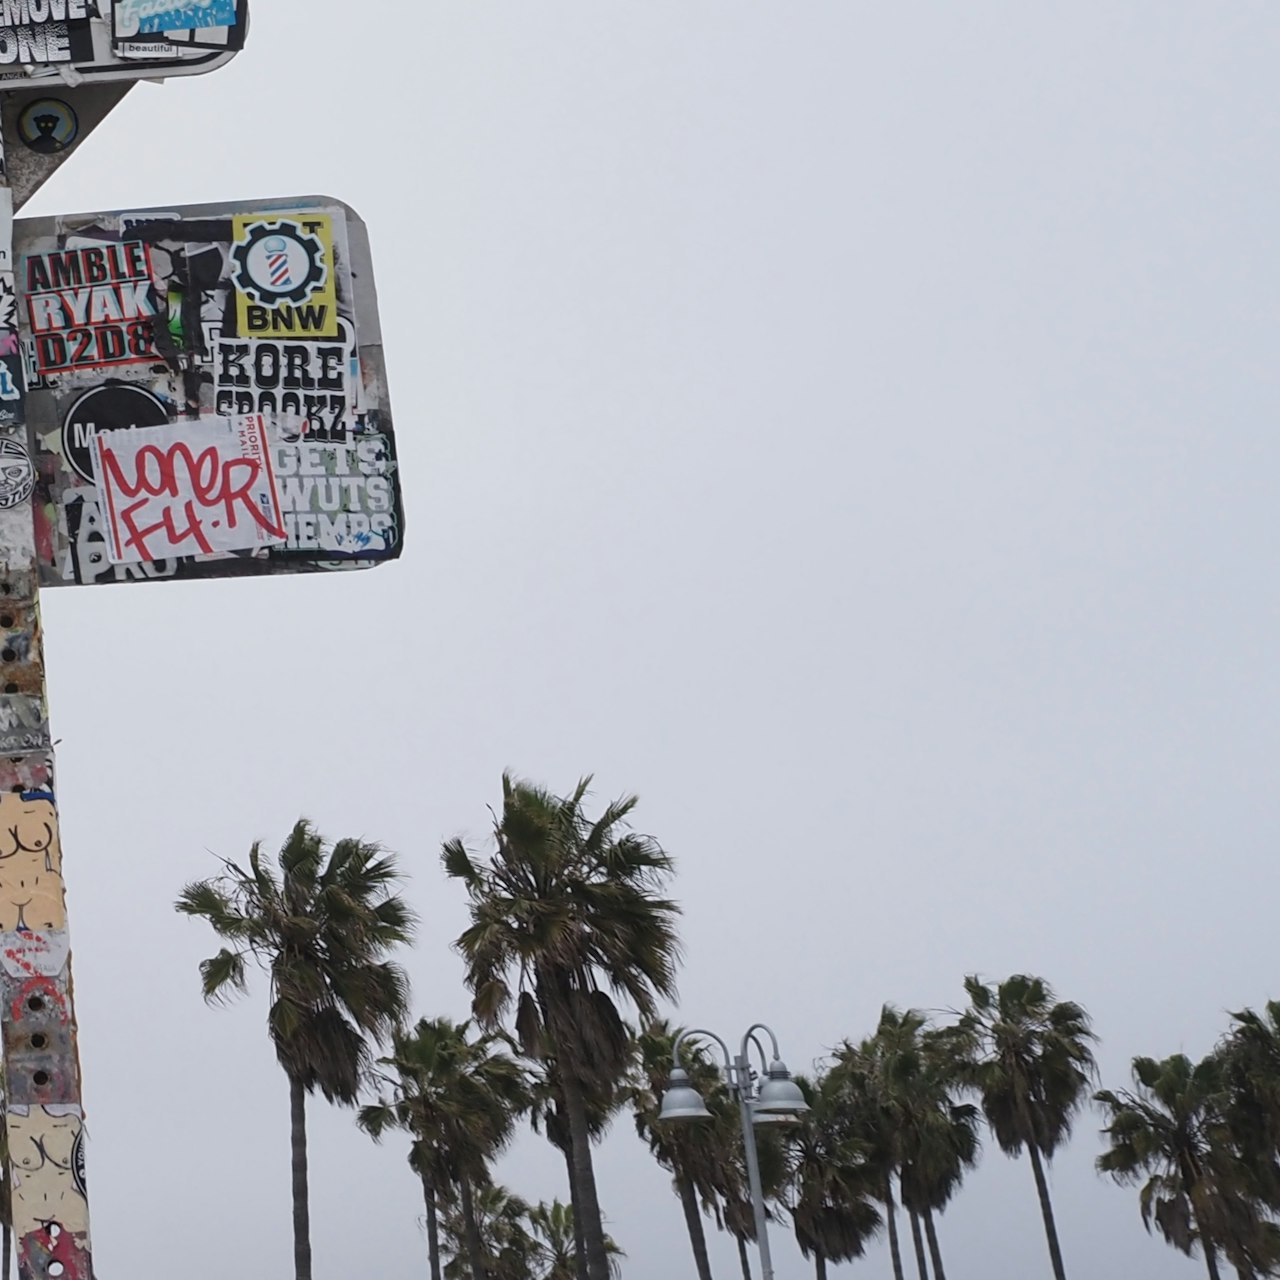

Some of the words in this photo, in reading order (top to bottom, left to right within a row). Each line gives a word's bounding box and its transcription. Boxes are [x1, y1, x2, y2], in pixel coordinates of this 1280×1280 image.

[128, 44, 173, 53] beautiful
[26, 241, 146, 292] AMBLE
[27, 279, 158, 333] RYAK
[246, 304, 328, 332] BNW
[216, 341, 346, 392] KORE
[273, 439, 387, 476] GETS
[277, 476, 390, 512] WUTS
